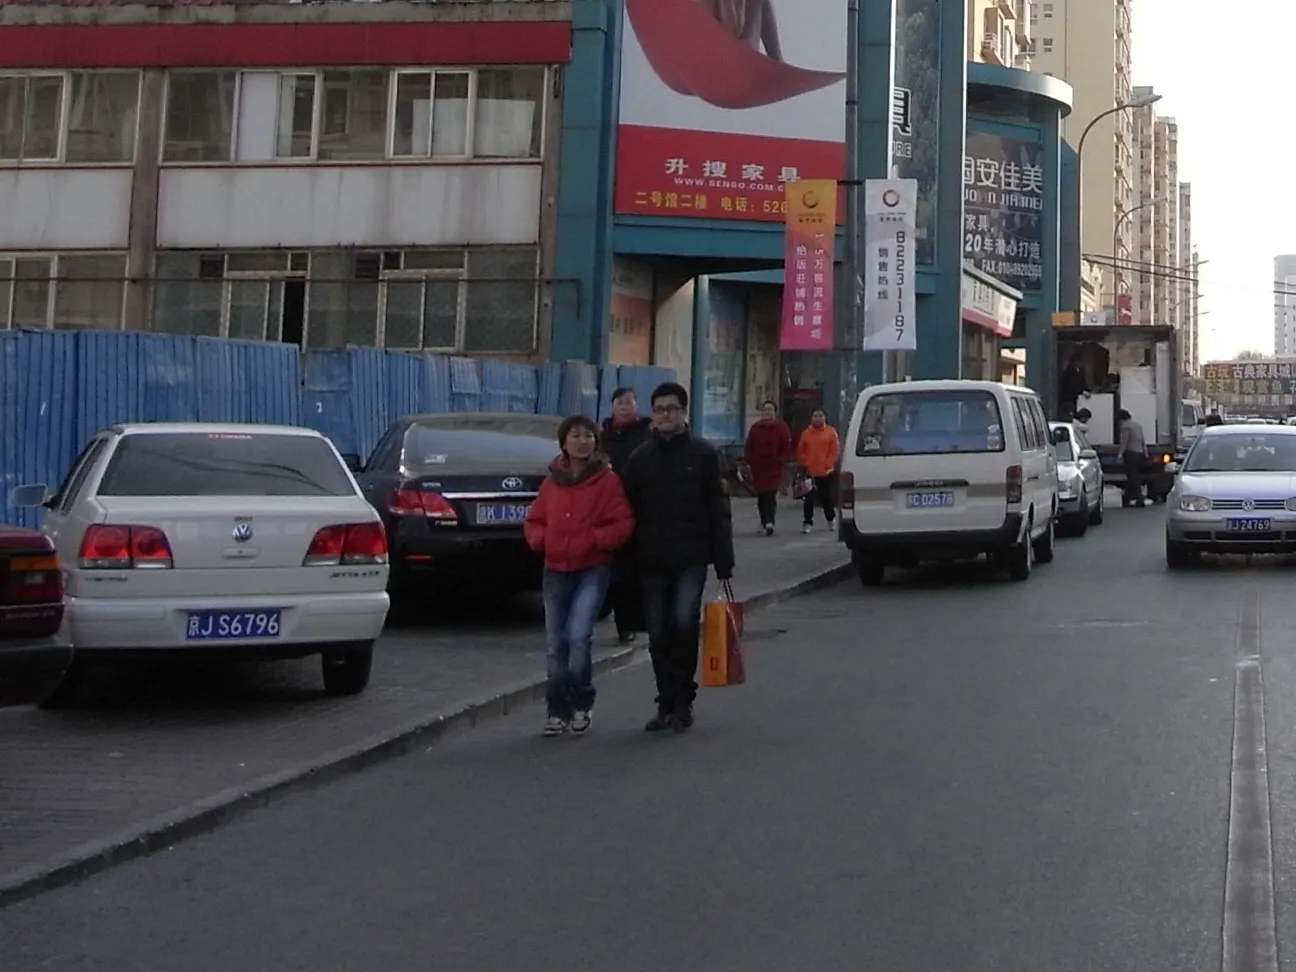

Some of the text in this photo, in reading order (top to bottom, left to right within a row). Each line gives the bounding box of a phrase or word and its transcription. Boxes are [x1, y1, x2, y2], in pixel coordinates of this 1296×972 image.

[665, 158, 800, 183] 升搜家具
[964, 156, 1043, 194] 国安佳美
[635, 191, 707, 210] 二号馆二楼
[895, 230, 906, 341] 82231187
[188, 613, 279, 637] 京JS6796
